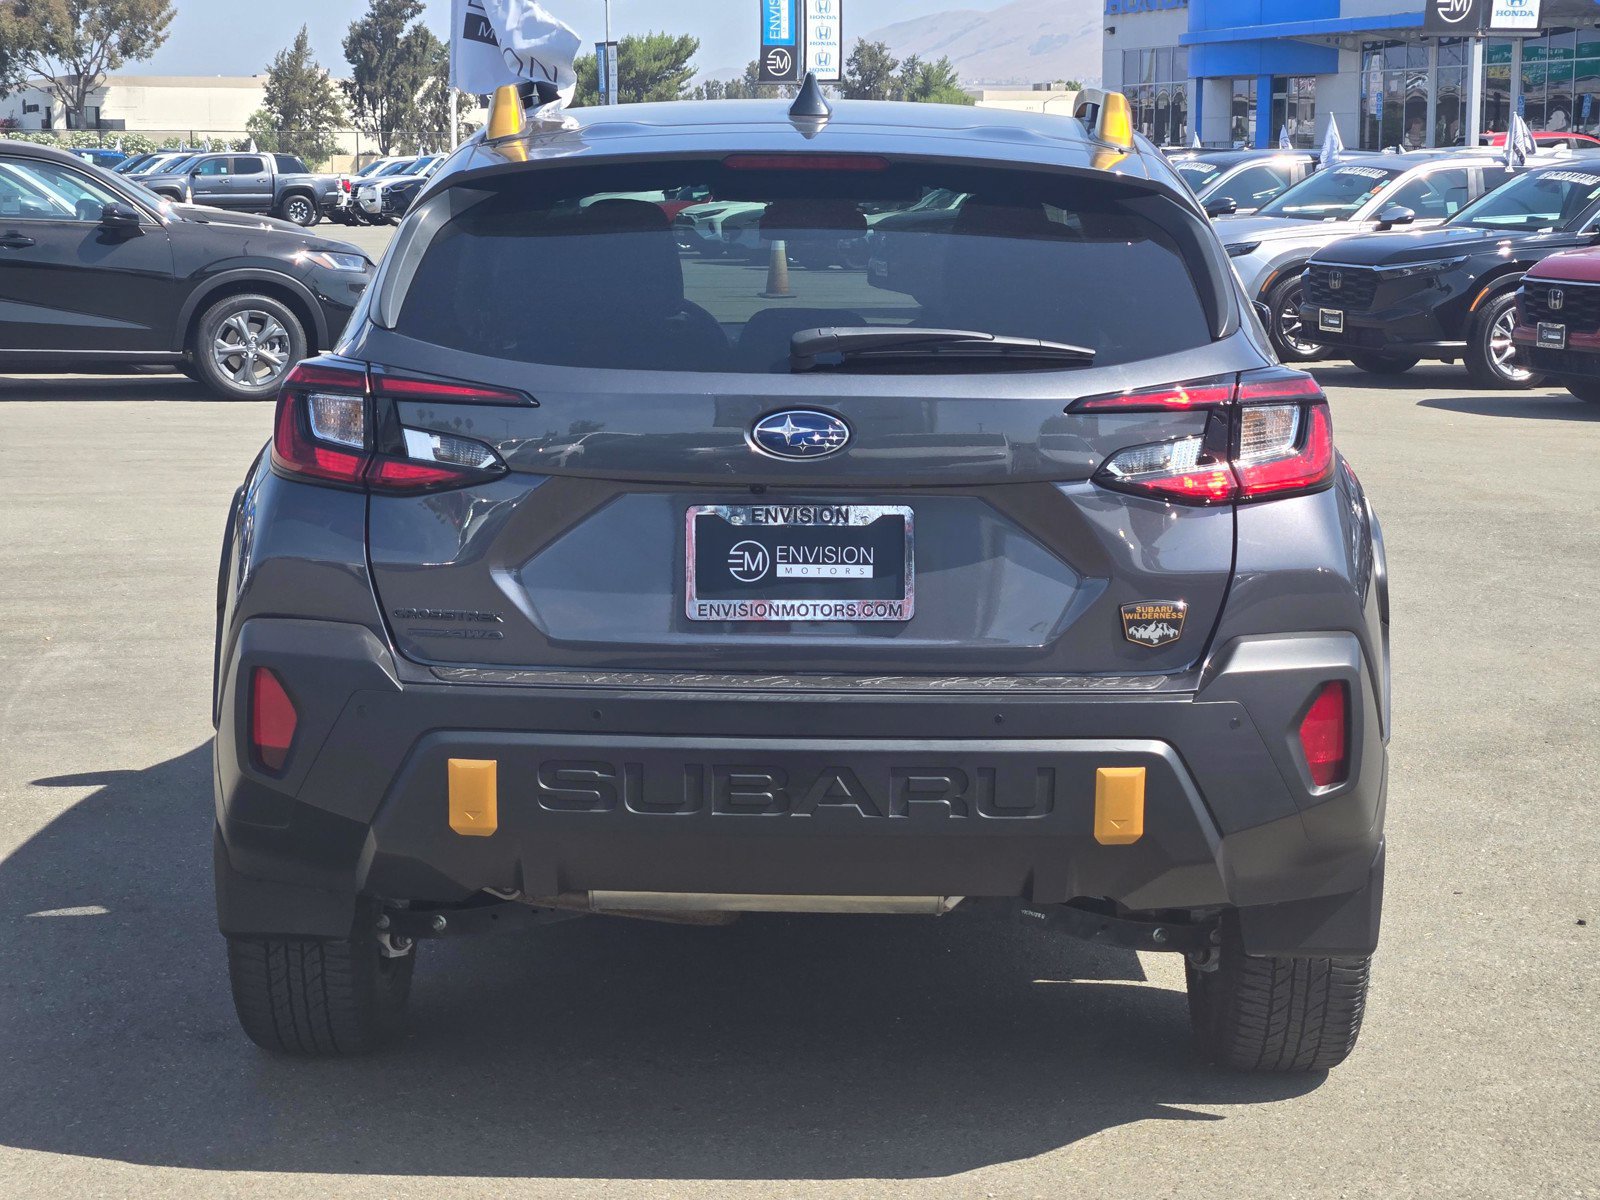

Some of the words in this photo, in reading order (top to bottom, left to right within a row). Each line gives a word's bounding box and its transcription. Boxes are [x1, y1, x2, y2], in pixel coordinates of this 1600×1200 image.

[751, 506, 849, 523] ENVISION
[776, 546, 874, 564] ENVISION
[784, 566, 865, 576] MOTORS
[697, 603, 903, 617] ENVISIONMOTORS.COM
[1124, 612, 1184, 620] WILDERNESS
[536, 758, 1057, 821] SUBARU
